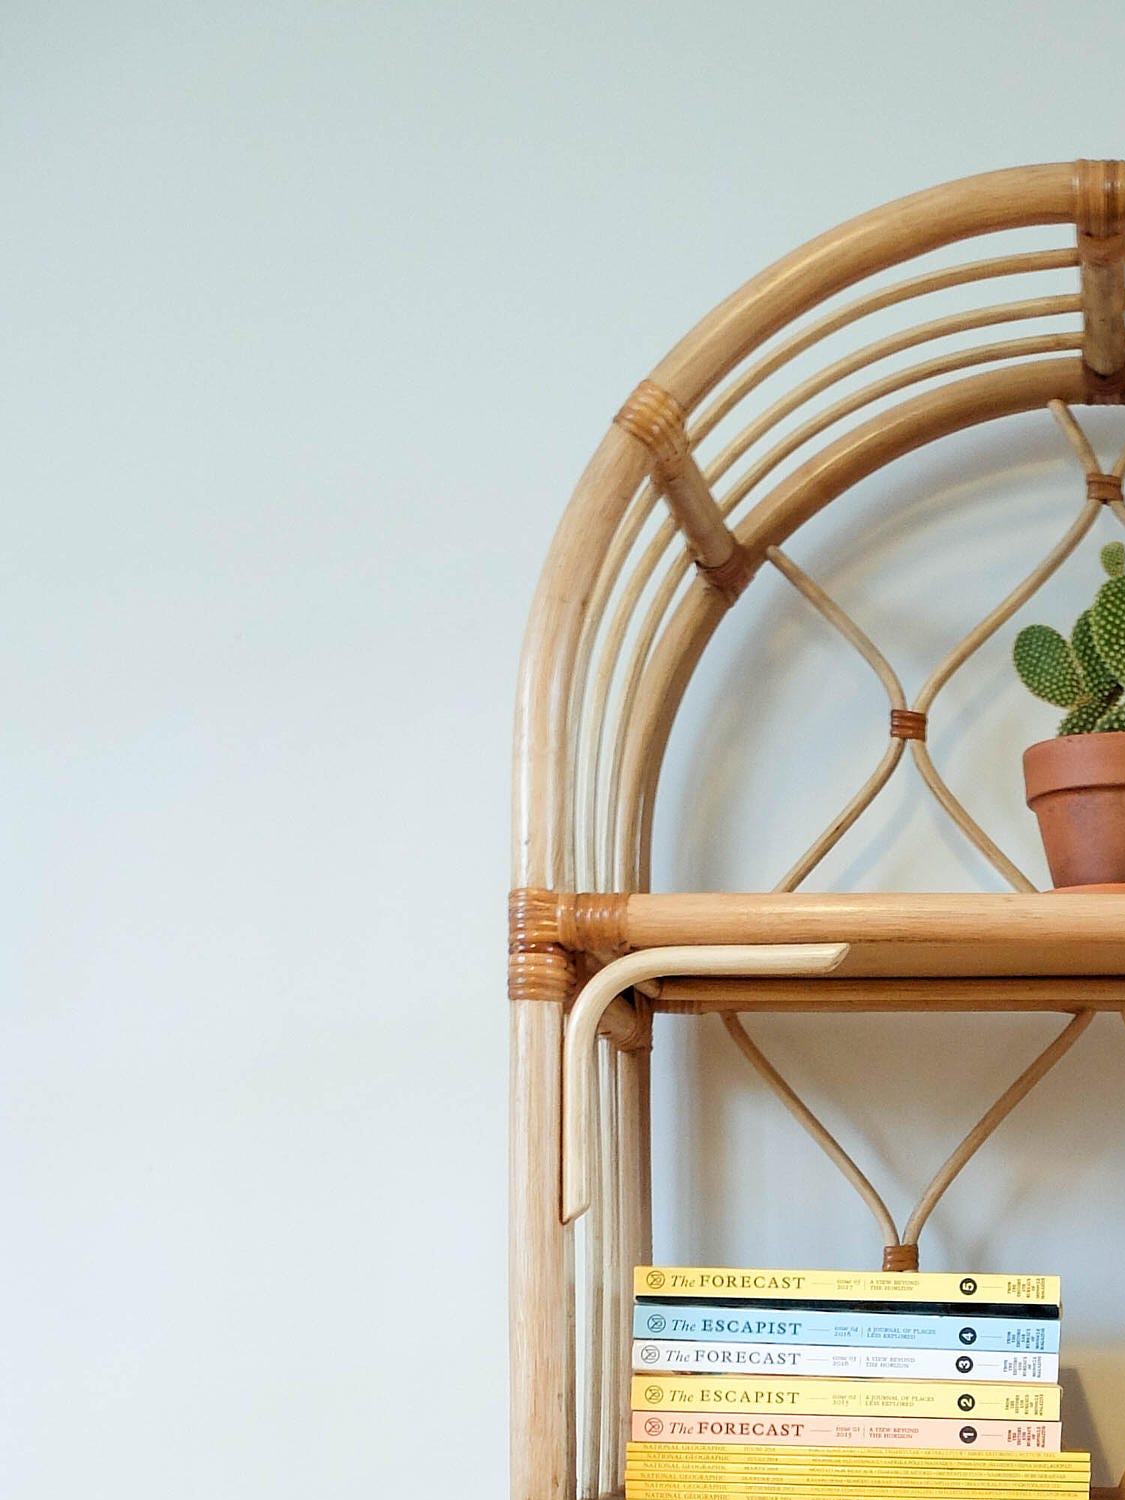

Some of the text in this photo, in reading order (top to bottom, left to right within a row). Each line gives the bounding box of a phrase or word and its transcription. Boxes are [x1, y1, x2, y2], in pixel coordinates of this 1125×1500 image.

[671, 1275, 806, 1289] The FORECAST
[672, 1319, 802, 1335] The ESCAPIST
[666, 1350, 801, 1365] The FORECAST
[669, 1390, 800, 1404] The ESCAPIST
[669, 1422, 804, 1436] The FORECAST
